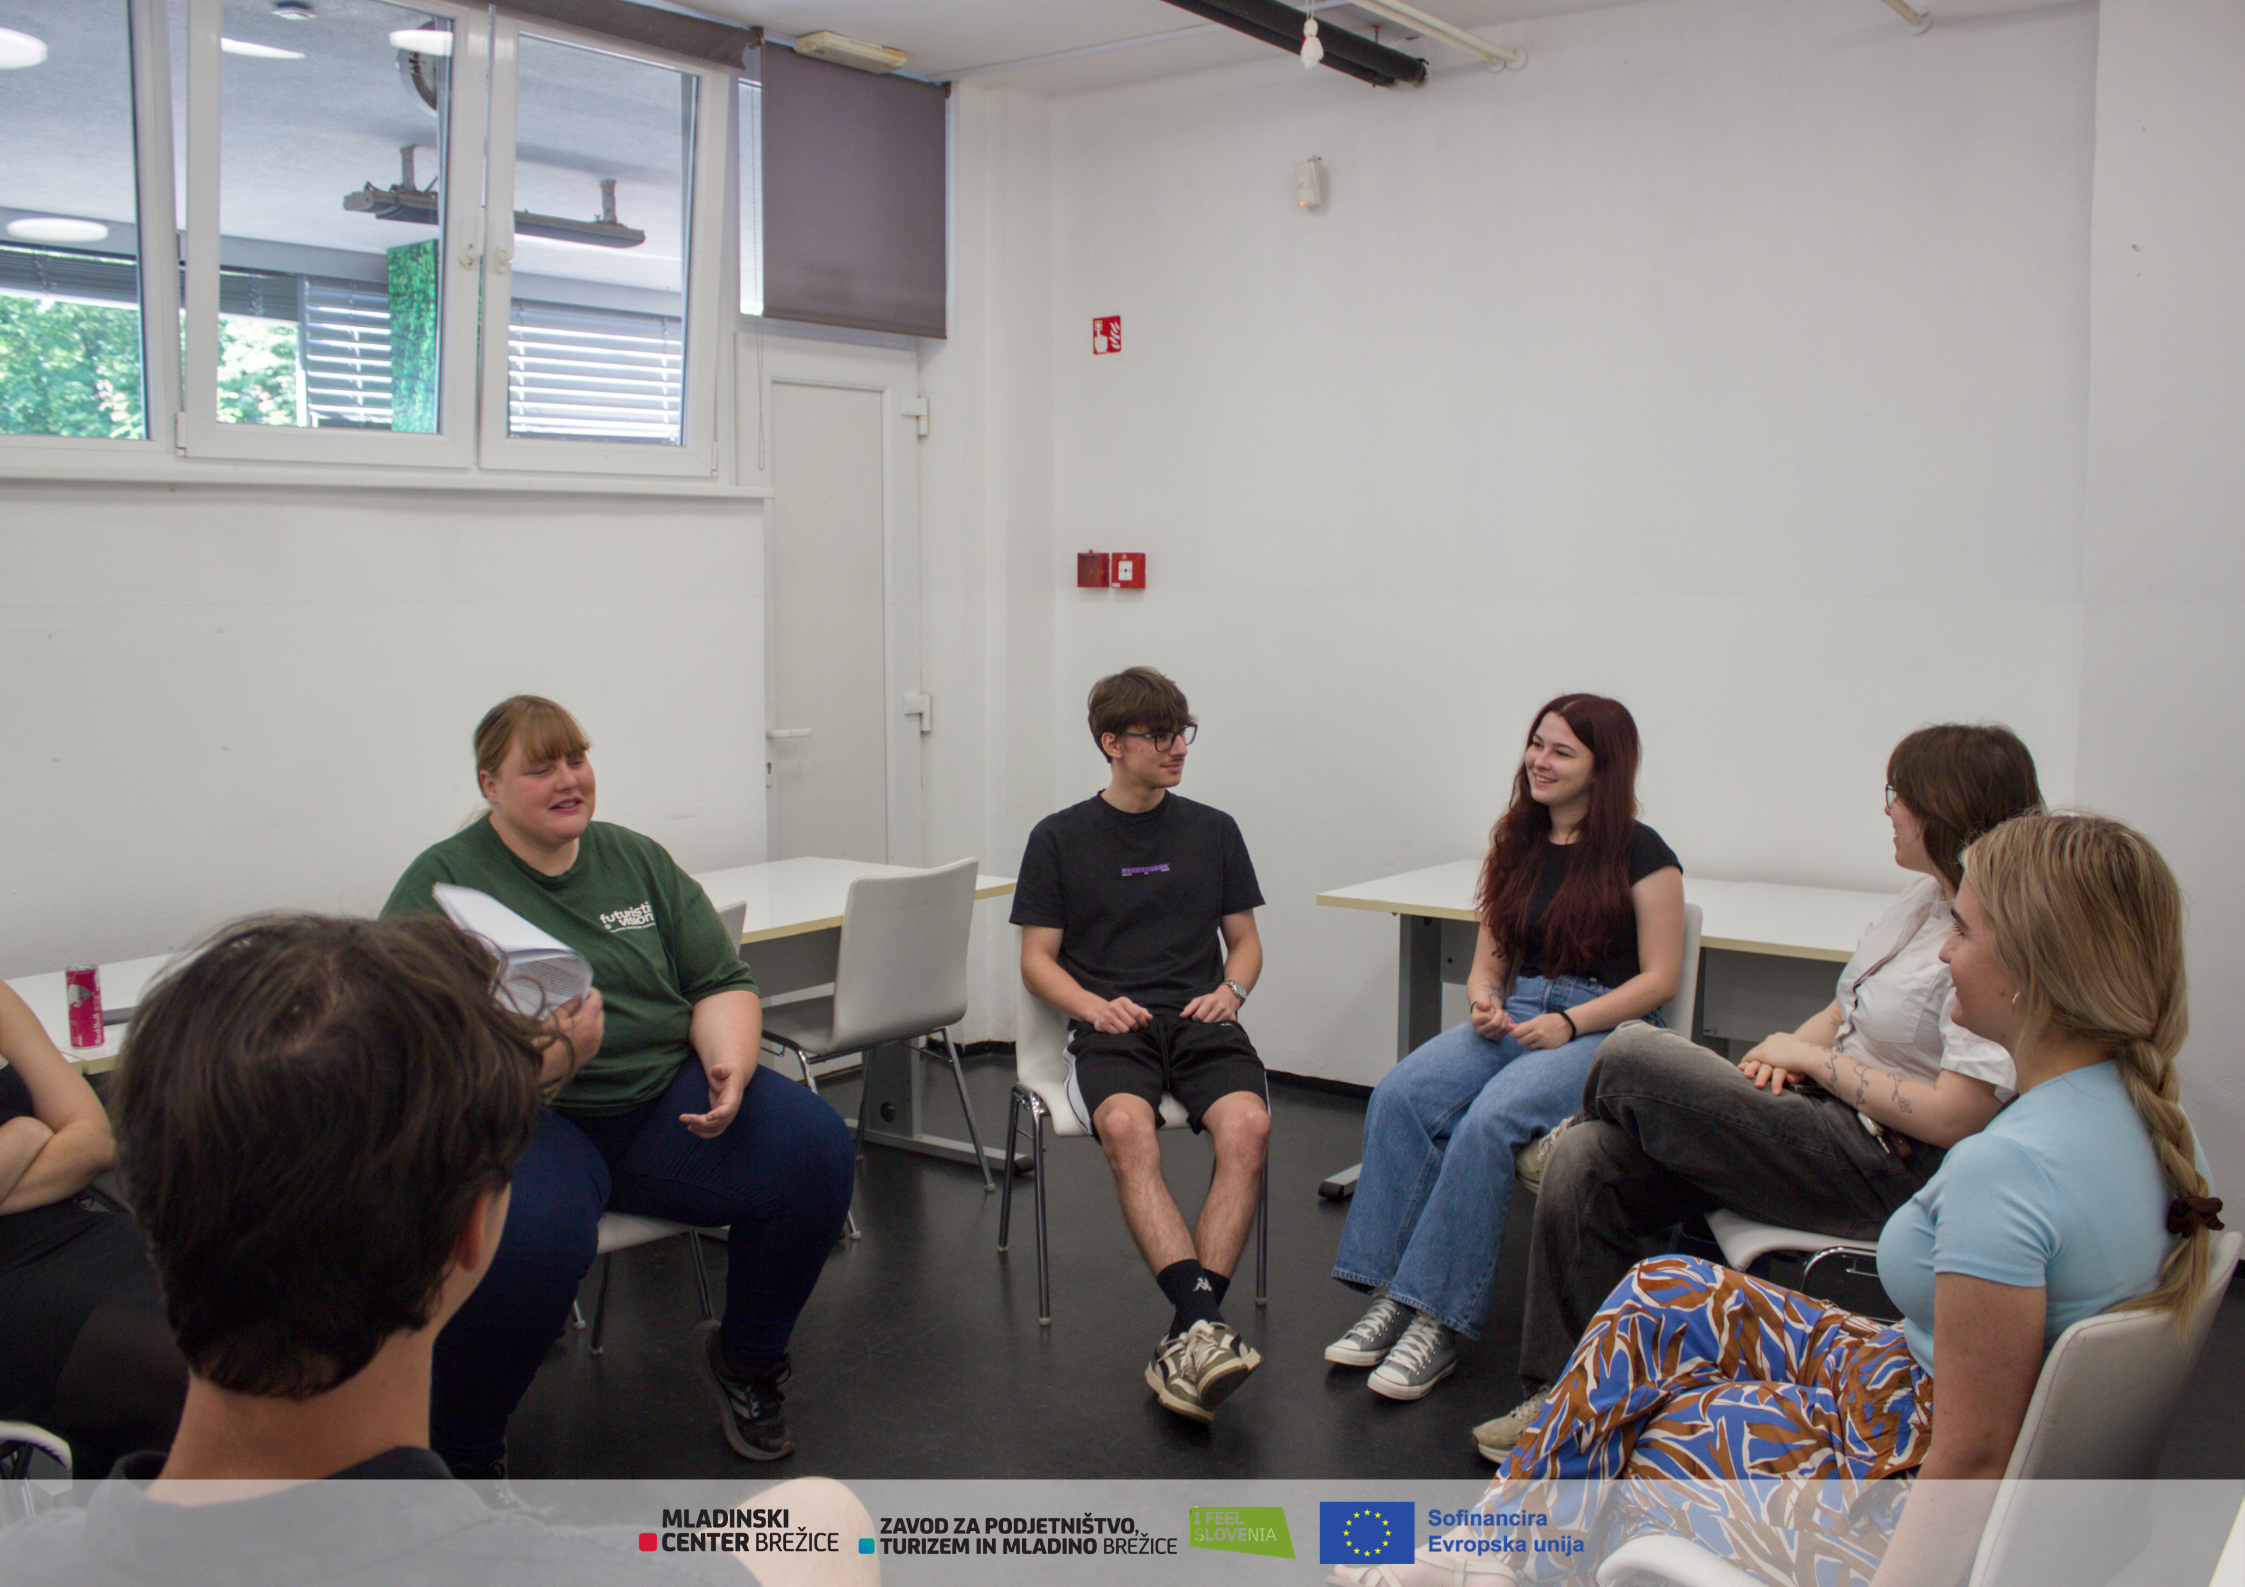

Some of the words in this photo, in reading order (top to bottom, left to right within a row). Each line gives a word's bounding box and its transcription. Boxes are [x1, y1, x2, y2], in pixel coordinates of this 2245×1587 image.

[599, 901, 653, 925] futuristi
[617, 912, 655, 927] vision
[94, 1028, 102, 1045] Red
